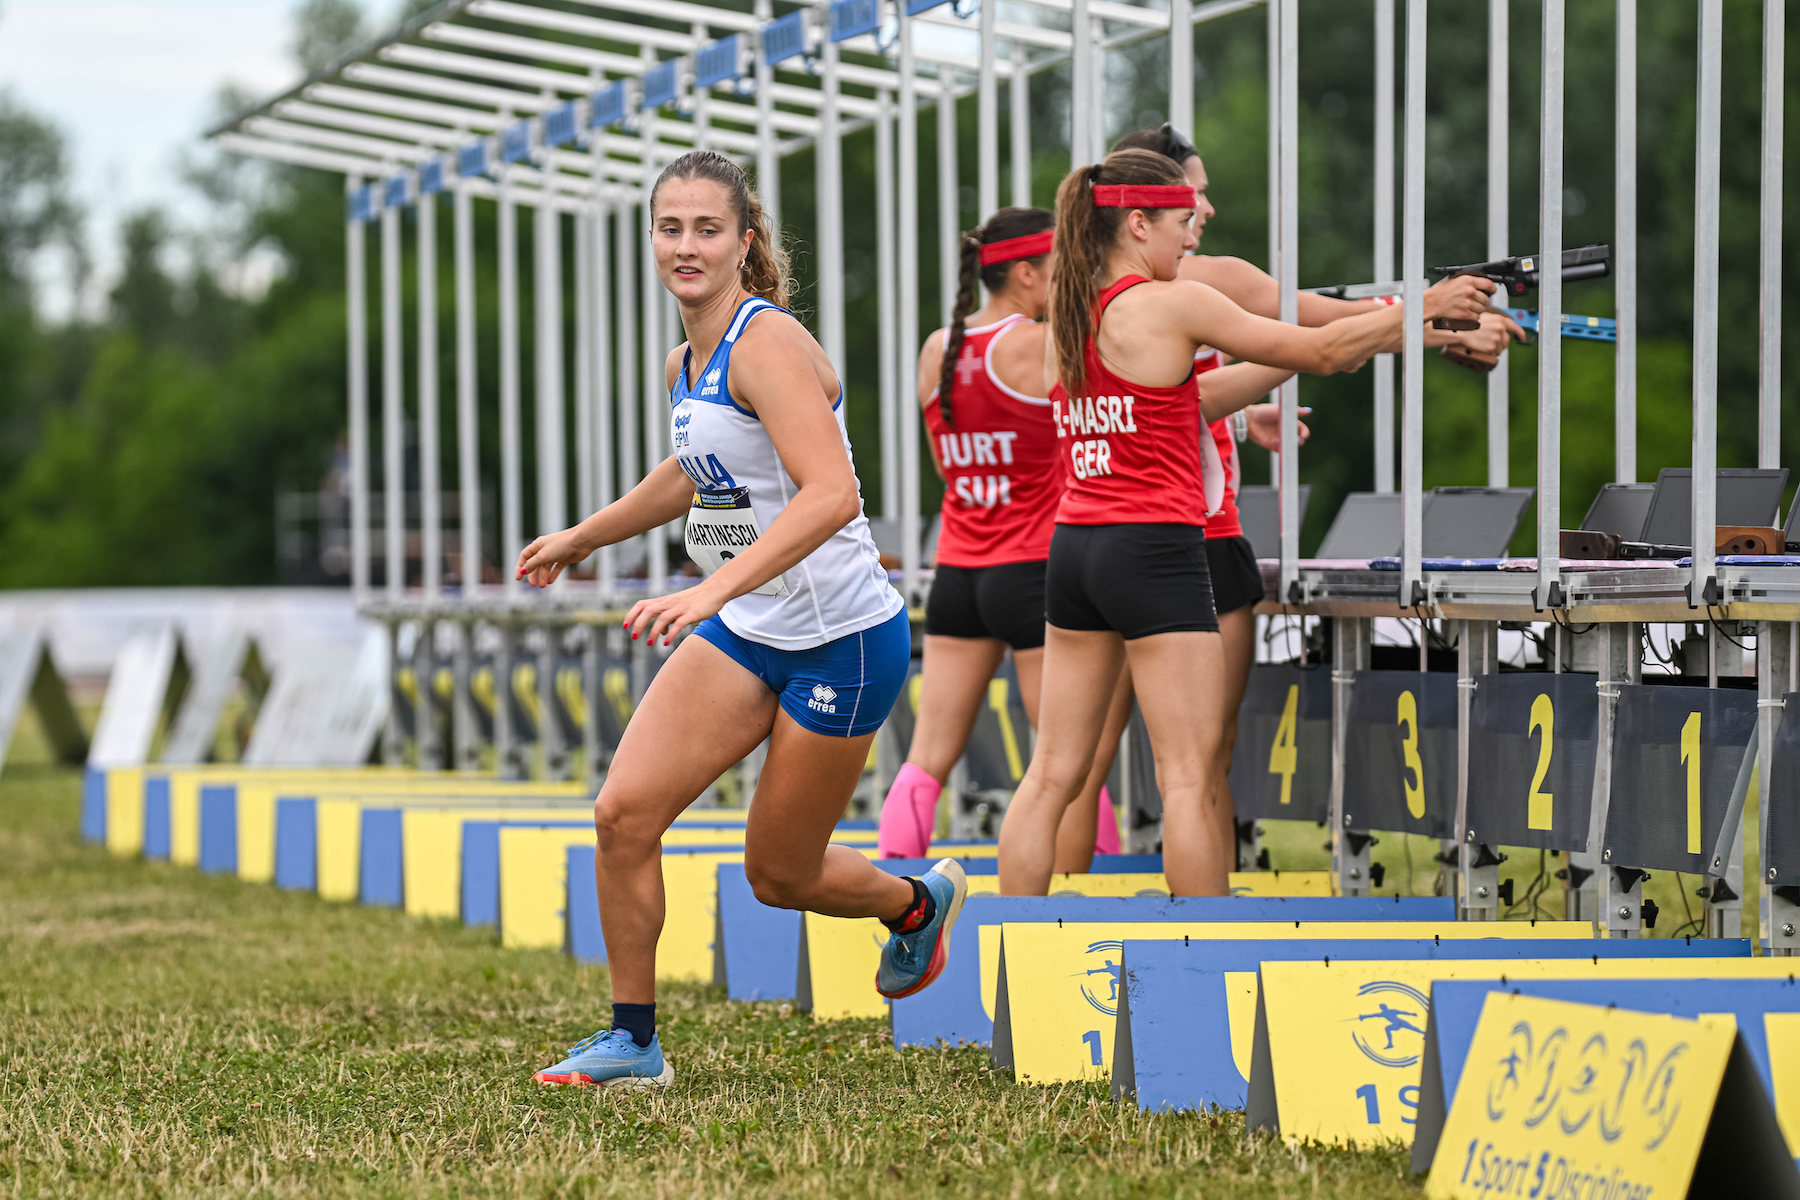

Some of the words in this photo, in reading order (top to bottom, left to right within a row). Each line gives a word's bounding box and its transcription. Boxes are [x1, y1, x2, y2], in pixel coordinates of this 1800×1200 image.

[1071, 439, 1113, 480] GER
[687, 521, 759, 547] MARTINESCU
[807, 698, 836, 713] errea
[1269, 684, 1299, 804] 4
[1397, 690, 1426, 819] 3
[1528, 693, 1554, 830] 2
[1681, 711, 1702, 854] 1
[1082, 1030, 1103, 1066] 1
[1356, 1084, 1381, 1124] 1
[1461, 1137, 1478, 1185] 1
[1473, 1142, 1532, 1200] Sport
[1529, 1151, 1550, 1199] 5
